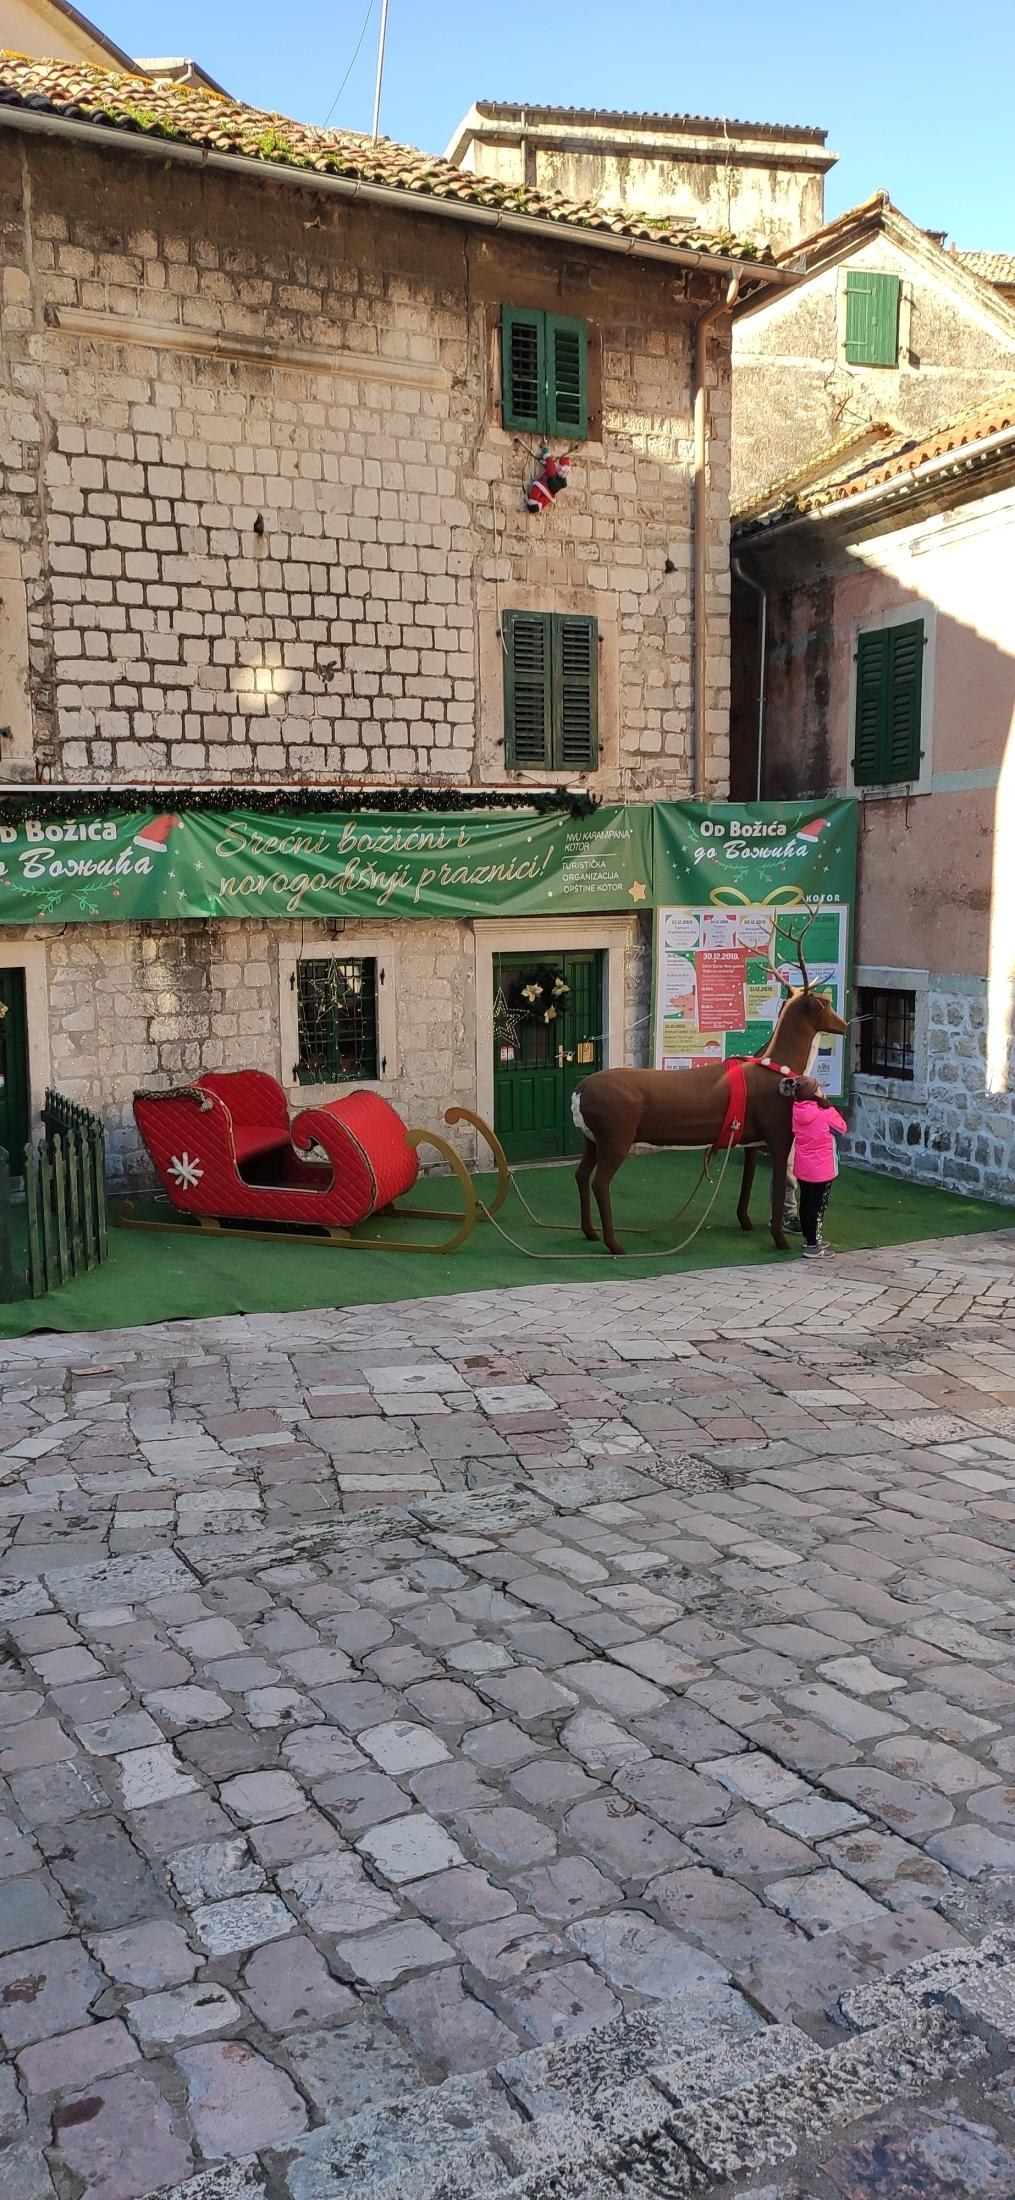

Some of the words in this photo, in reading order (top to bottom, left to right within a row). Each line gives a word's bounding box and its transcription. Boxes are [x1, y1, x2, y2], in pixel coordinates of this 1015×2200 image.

[730, 820, 787, 837] Božića
[215, 821, 331, 857] Srećni
[337, 820, 452, 855] božićni
[457, 824, 472, 848] i
[564, 841, 590, 852] KOTOR
[562, 859, 607, 870] TURISTIČKA
[218, 856, 413, 912] novogodišnji
[413, 845, 555, 904] praznici!
[561, 871, 620, 882] ORGANIZACIJA
[563, 883, 596, 894] OPŠTINE
[597, 883, 624, 892] KOTOR
